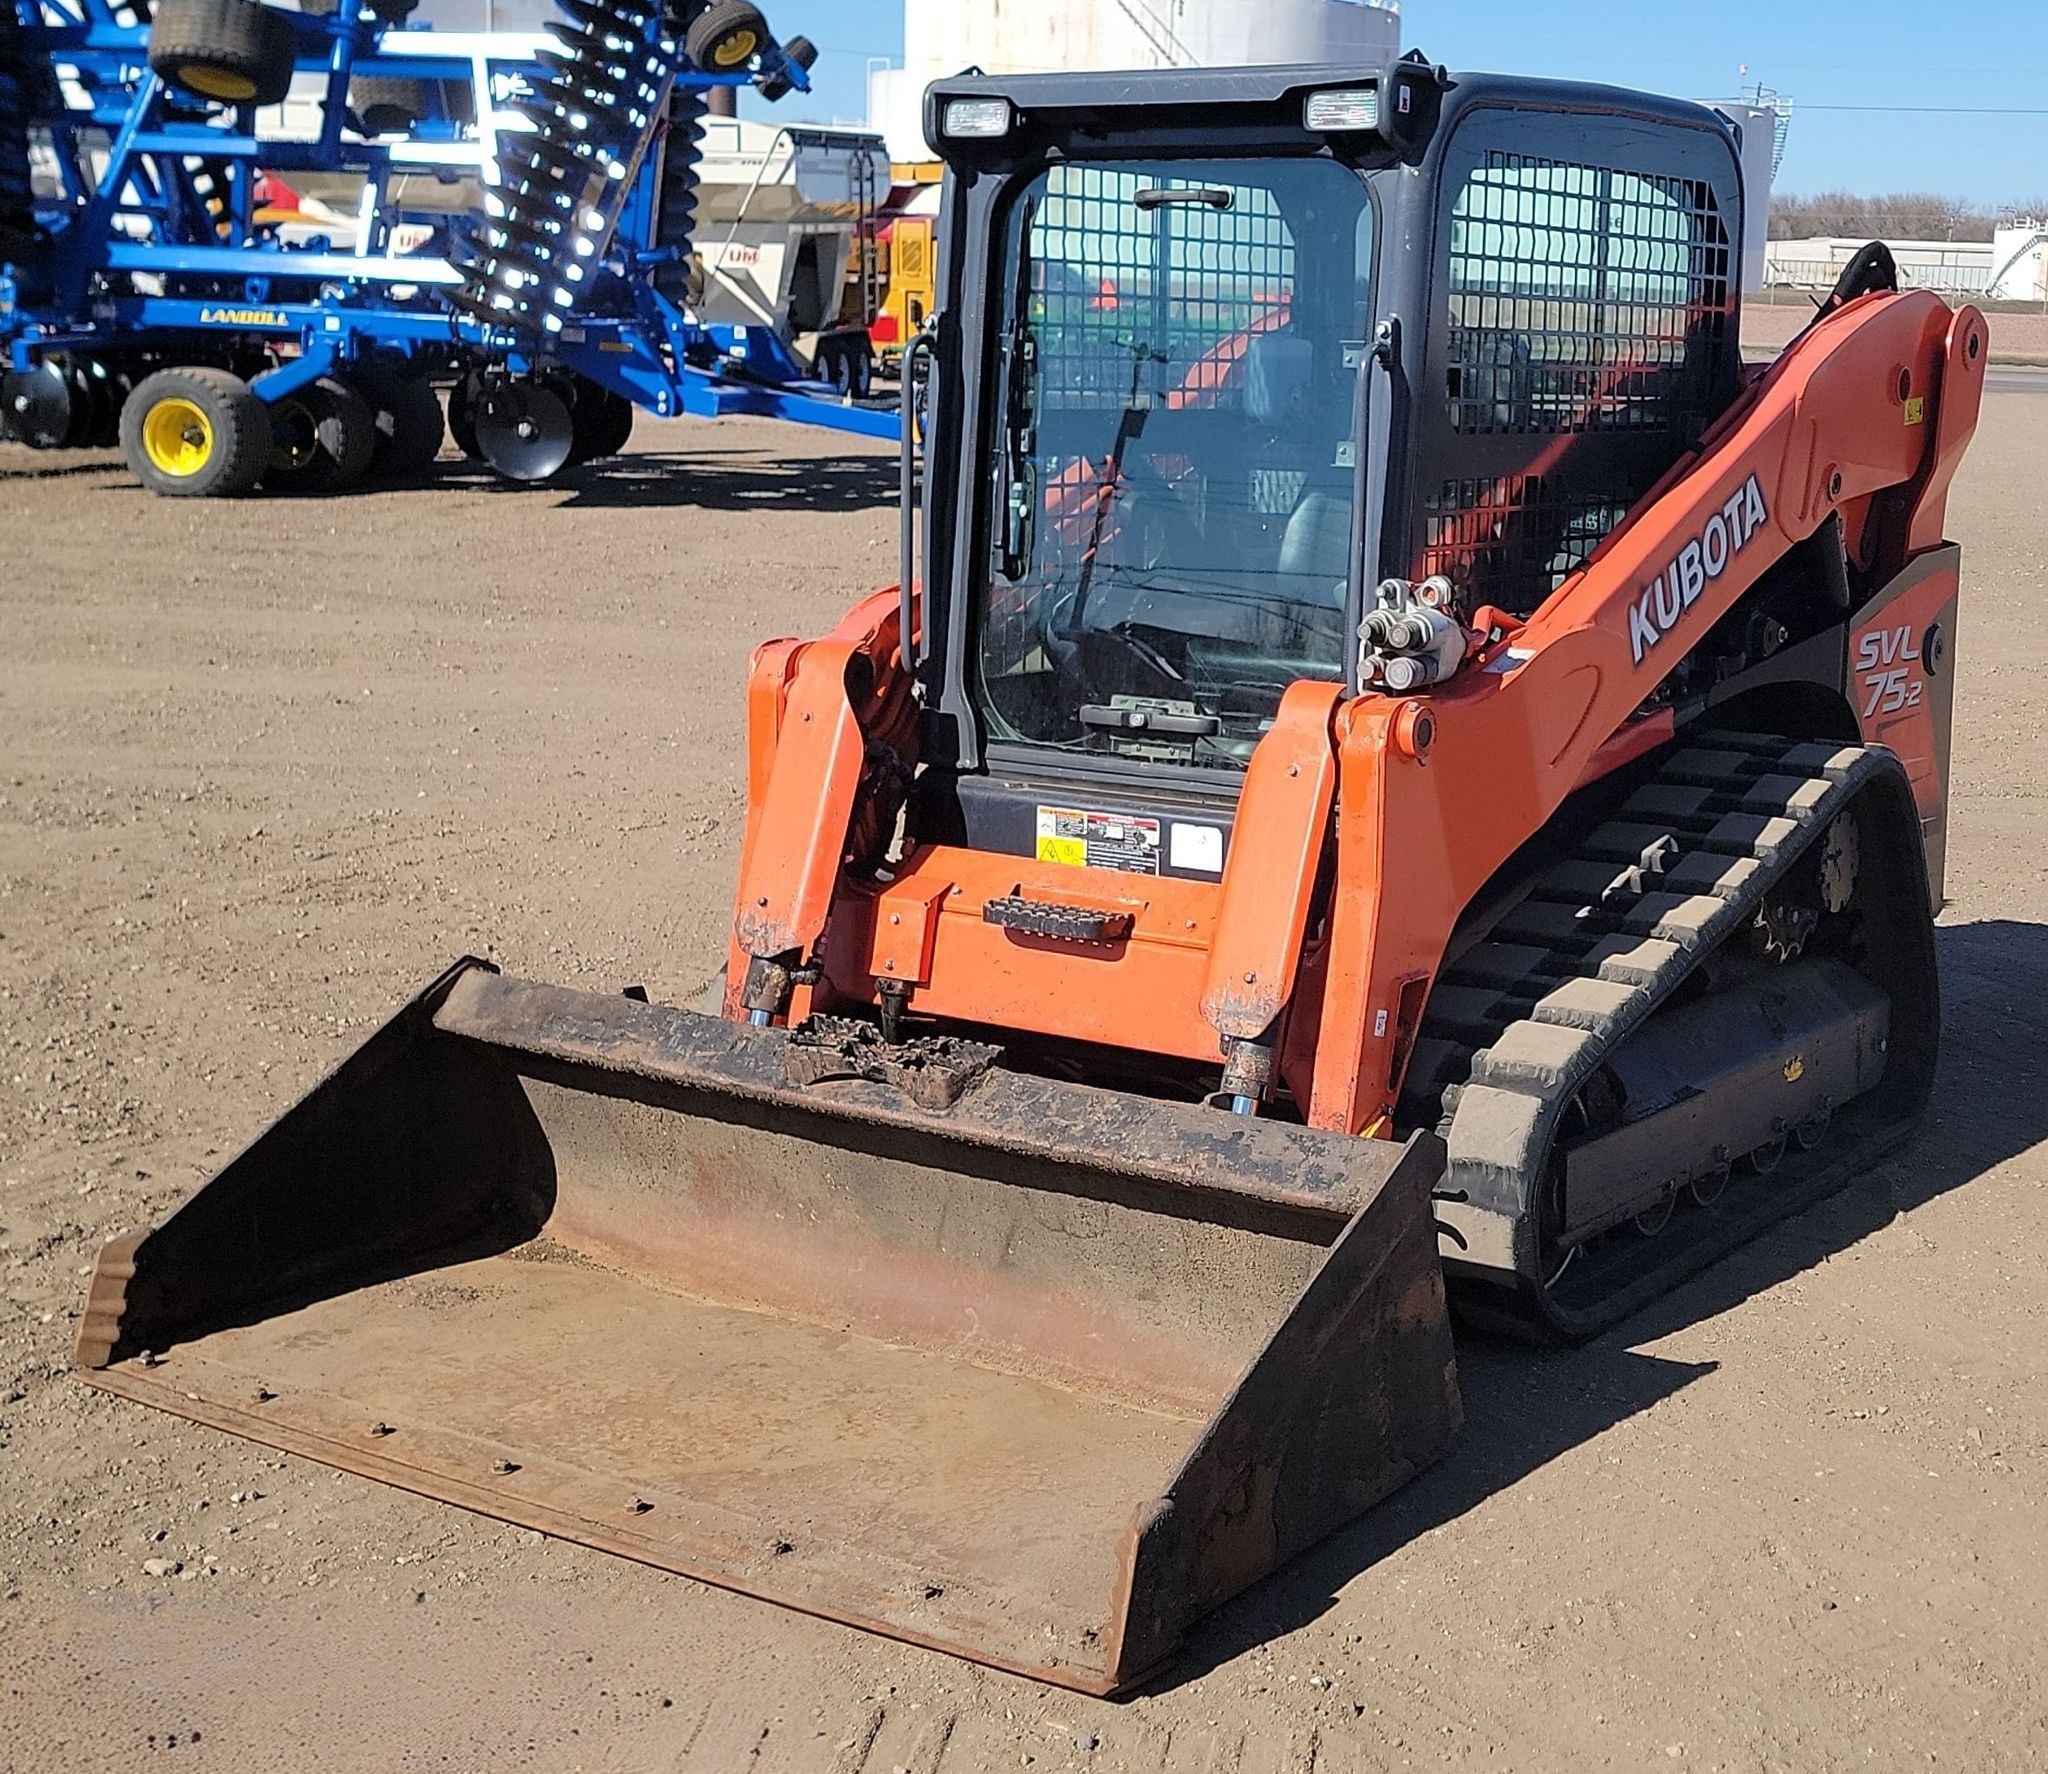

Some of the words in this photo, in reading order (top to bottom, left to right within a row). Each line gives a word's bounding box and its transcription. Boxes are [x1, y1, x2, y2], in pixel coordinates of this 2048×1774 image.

[730, 250, 758, 264] UM
[200, 308, 289, 326] LANDOLL
[1628, 474, 1767, 665] KUBOTA
[1856, 625, 1919, 671] SVL
